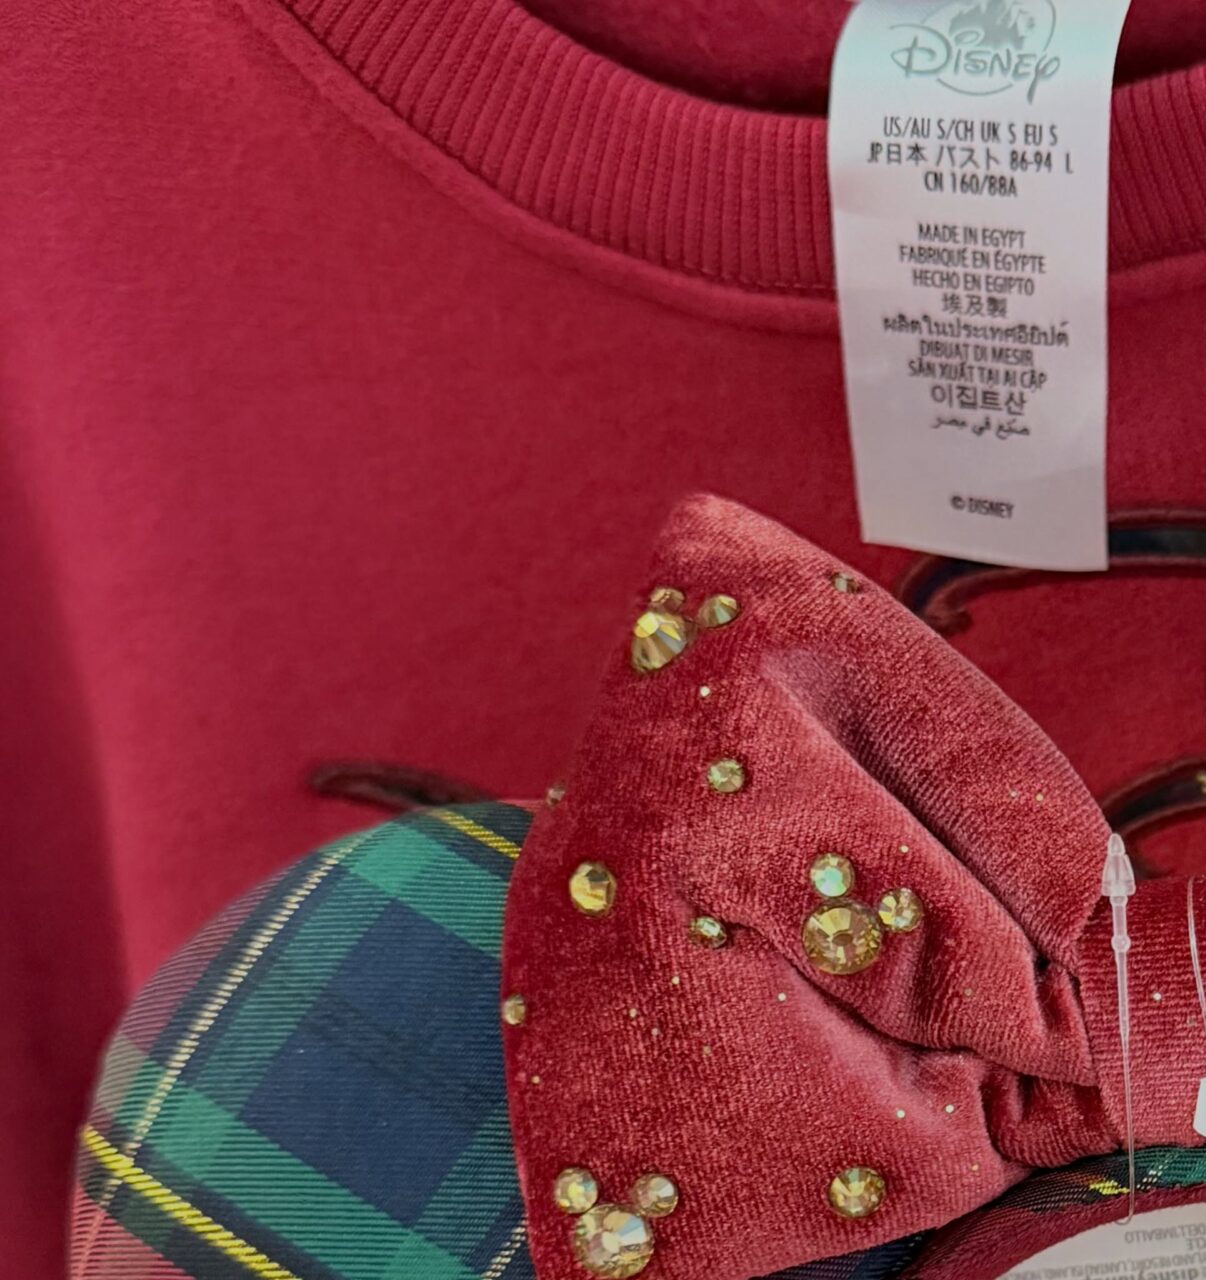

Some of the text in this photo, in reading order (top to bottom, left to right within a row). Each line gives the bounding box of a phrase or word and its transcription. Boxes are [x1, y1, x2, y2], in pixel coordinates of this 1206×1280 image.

[883, 116, 1058, 147] US/AU S/CH UK S EU S
[1009, 150, 1052, 173] 86-94
[1065, 152, 1074, 174] L
[924, 171, 1018, 198] CN 160/88A
[918, 222, 1027, 250] MADE IN EGYPT
[899, 245, 1047, 274] FABRIQUÉ EN ÉGYPTE
[912, 269, 1035, 296] HECHO EN EGIPTO
[919, 340, 1034, 367] DIBUAT DI MESIR
[968, 497, 1015, 519] DISNEY
